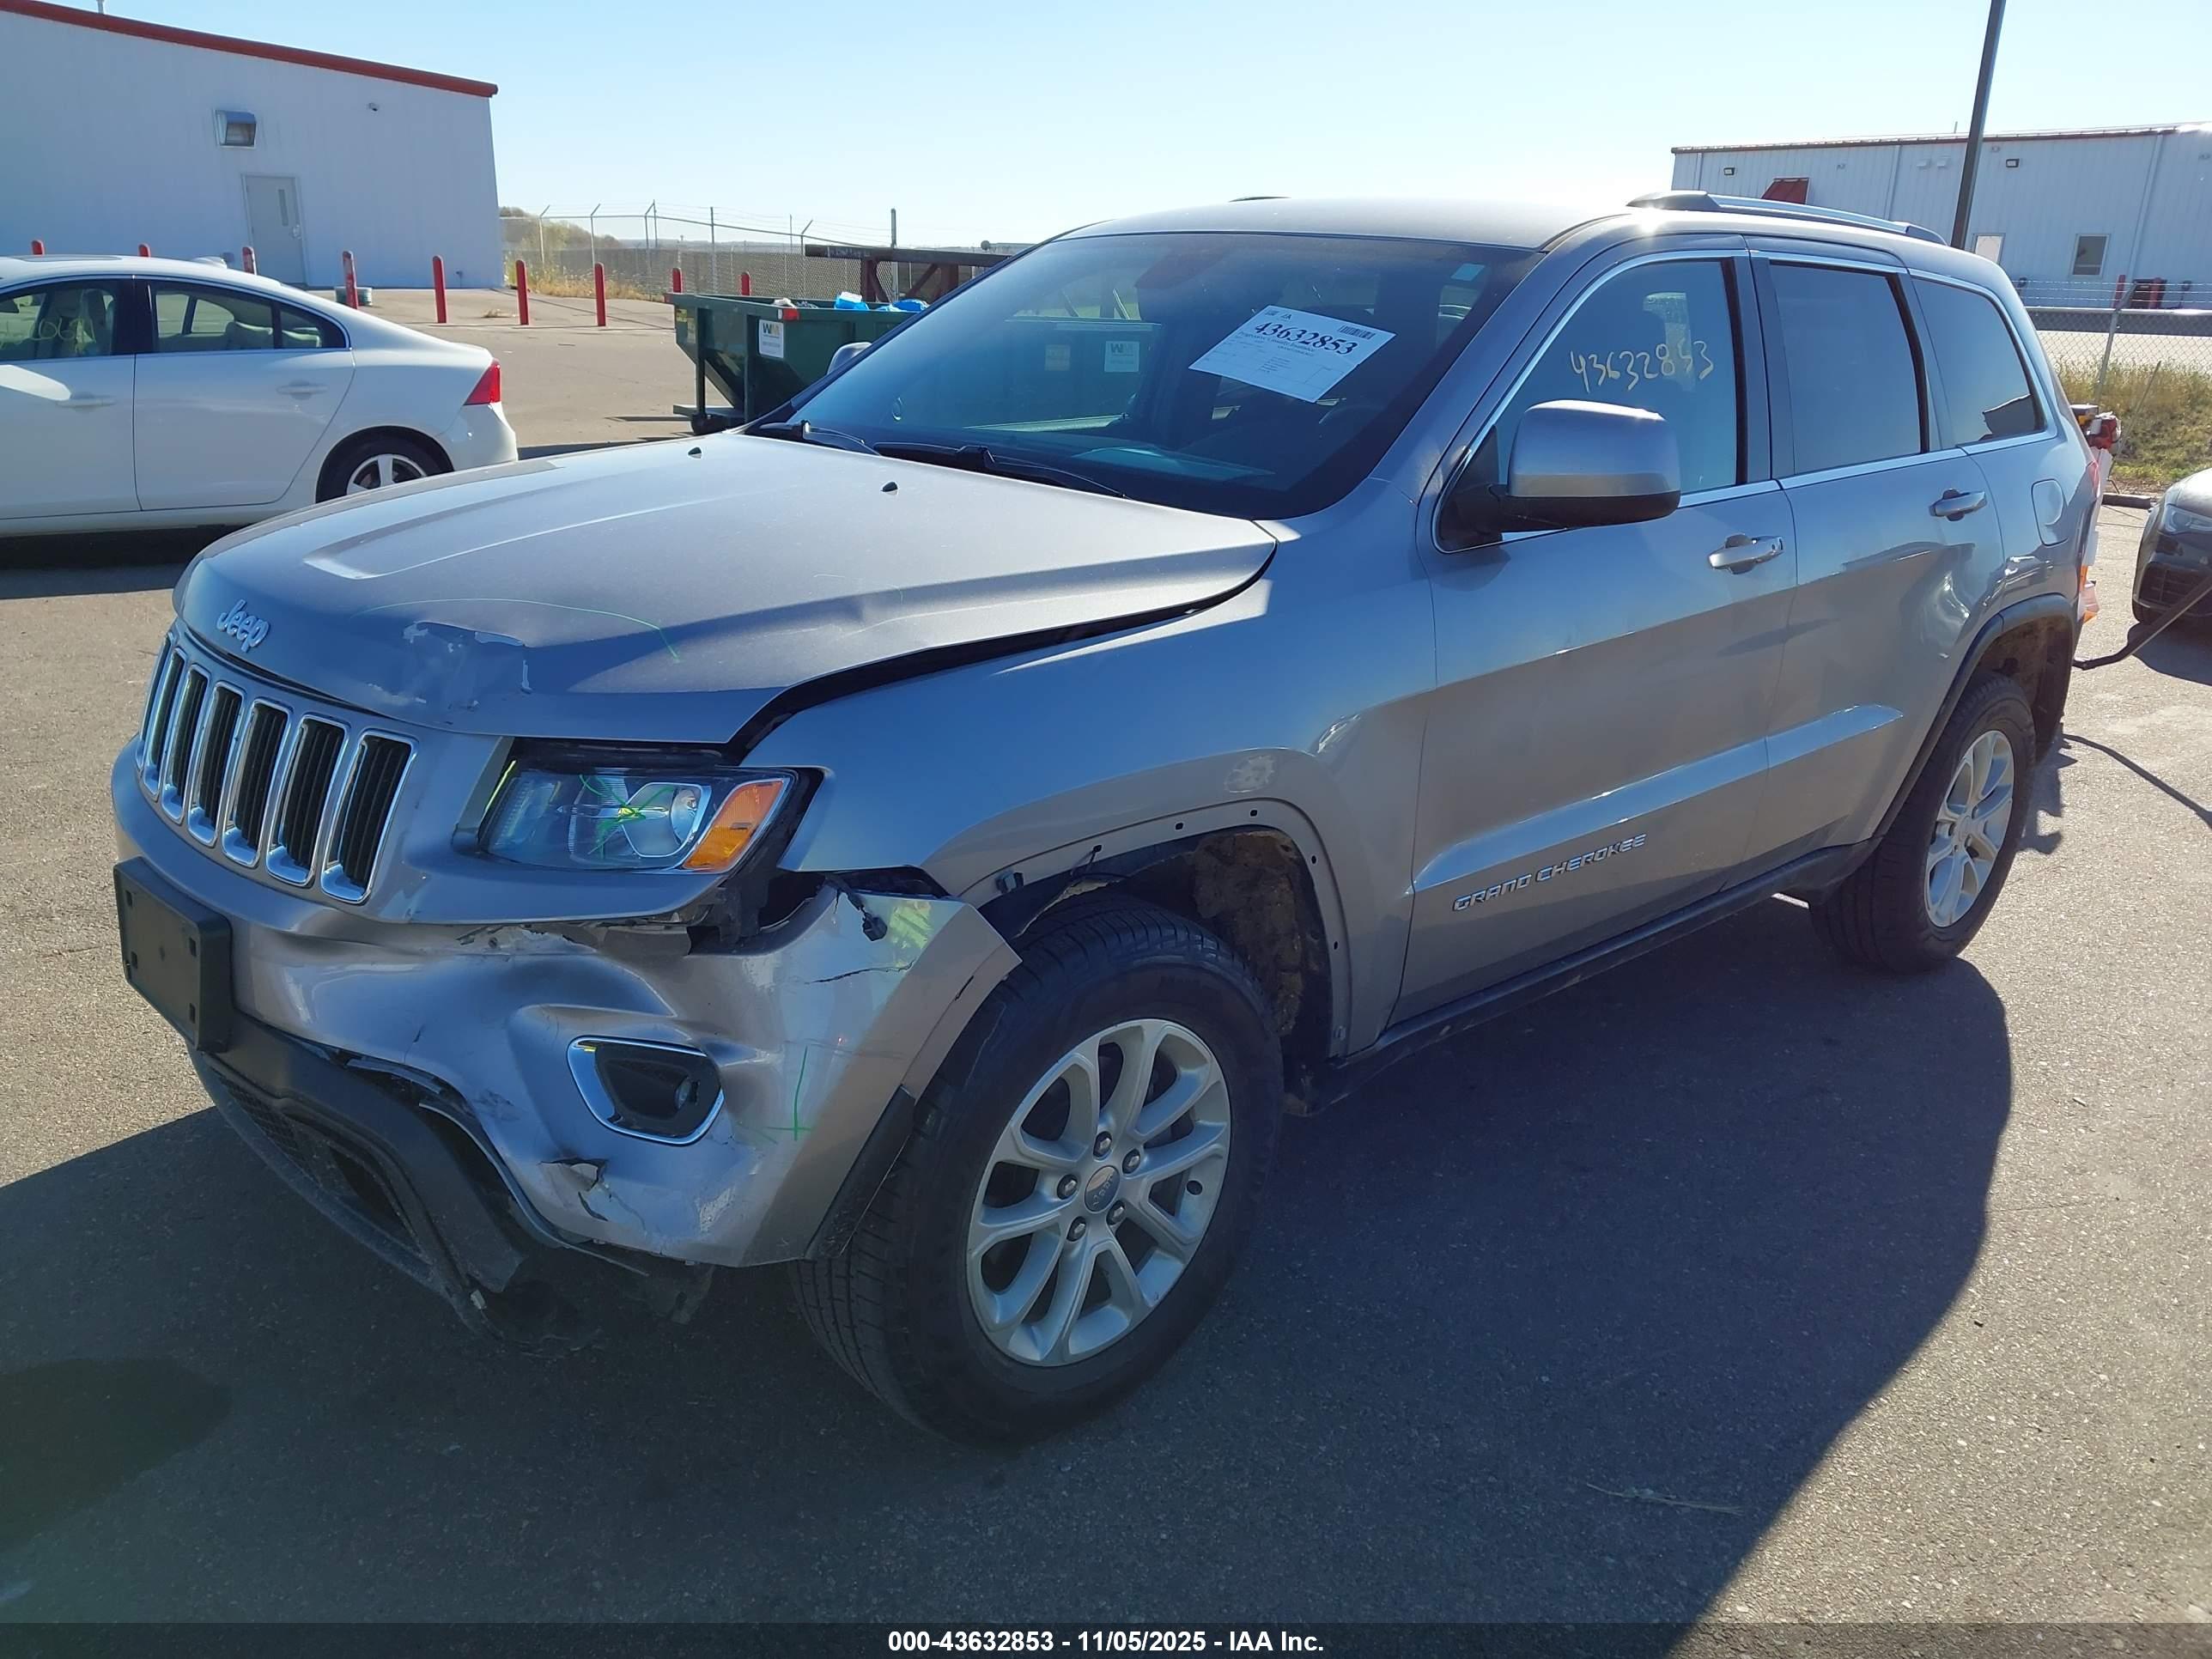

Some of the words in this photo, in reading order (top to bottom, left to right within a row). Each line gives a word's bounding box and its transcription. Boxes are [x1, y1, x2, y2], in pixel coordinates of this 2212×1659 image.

[1255, 322, 1358, 355] 43632853
[1570, 337, 1714, 393] 43632853
[216, 599, 270, 653] Jeep
[1453, 874, 1532, 911] GRAND
[1535, 834, 1646, 882] CHEROKEE
